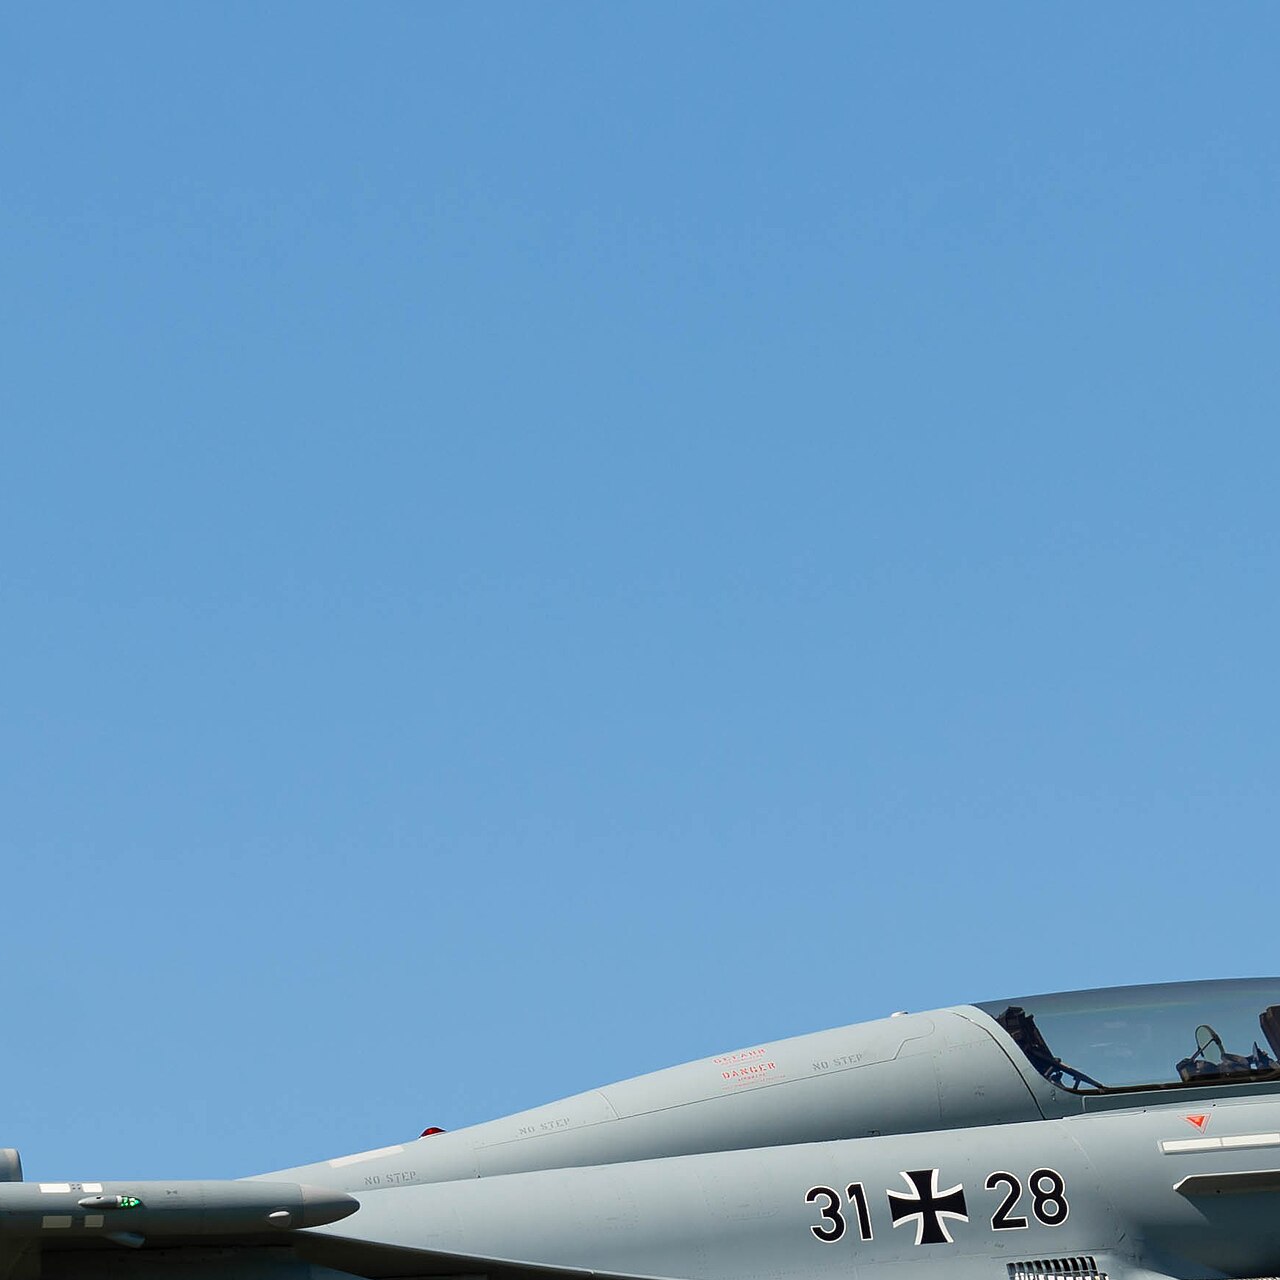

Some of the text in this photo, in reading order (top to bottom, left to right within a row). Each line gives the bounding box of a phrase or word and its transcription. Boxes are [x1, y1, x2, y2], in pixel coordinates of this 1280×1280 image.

[812, 1053, 863, 1070] NO STEP
[721, 1062, 776, 1079] DANGER
[363, 1170, 416, 1185] NO STEP
[804, 1167, 1070, 1243] 31 28
